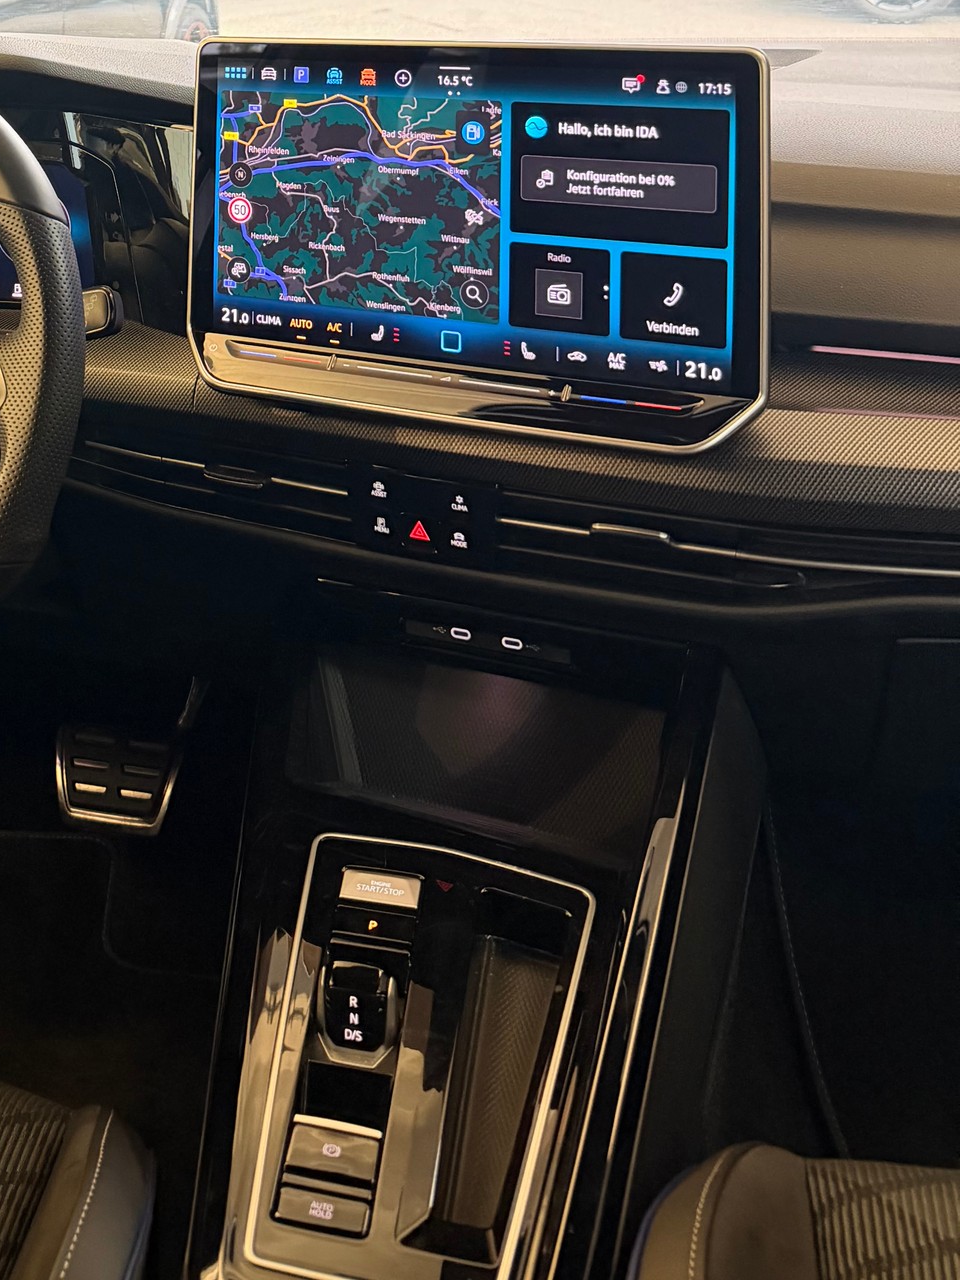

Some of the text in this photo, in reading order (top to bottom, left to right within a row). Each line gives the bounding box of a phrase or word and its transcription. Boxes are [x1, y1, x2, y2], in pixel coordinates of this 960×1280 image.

[437, 75, 459, 86] 16.5
[698, 82, 732, 96] 17:15
[381, 130, 396, 139] Bad
[558, 122, 659, 139] Hallo, ich bin IDA
[248, 145, 290, 155] Rheinfelden
[378, 165, 419, 176] Obermumpf
[448, 167, 469, 176] Eiken
[566, 169, 676, 187] Konfiguration bei 0%
[276, 181, 302, 190] Magden
[566, 184, 644, 199] Jetzt fortfahren
[234, 205, 247, 215] 50
[323, 205, 340, 213] Buus
[377, 214, 427, 225] Wegenstetten
[251, 232, 279, 243] Hersberg
[441, 234, 470, 244] Wittnau
[308, 241, 345, 252] Rickenbach
[547, 253, 571, 263] Radio
[282, 265, 307, 275] Sissach
[452, 265, 493, 276] Wölflinswil
[372, 271, 410, 282] Rothenfluh
[366, 300, 406, 312] Wenslingen
[428, 302, 461, 314] Kienberg
[221, 307, 342, 333] 21.0 CLIMA AUTO A/C
[646, 320, 700, 337] Verbinden
[607, 352, 626, 363] A/C
[684, 361, 723, 381] 21.0
[451, 503, 469, 512] CLIMA
[374, 525, 390, 534] MENU
[450, 539, 468, 549] MODE
[356, 883, 405, 896] START/STOP
[370, 880, 391, 888] ENGINE
[368, 920, 378, 931] P
[349, 995, 359, 1008] R
[349, 1012, 359, 1025] N
[344, 1028, 363, 1042] D/S
[310, 1200, 334, 1211] AUTO
[309, 1209, 334, 1220] HOLD
